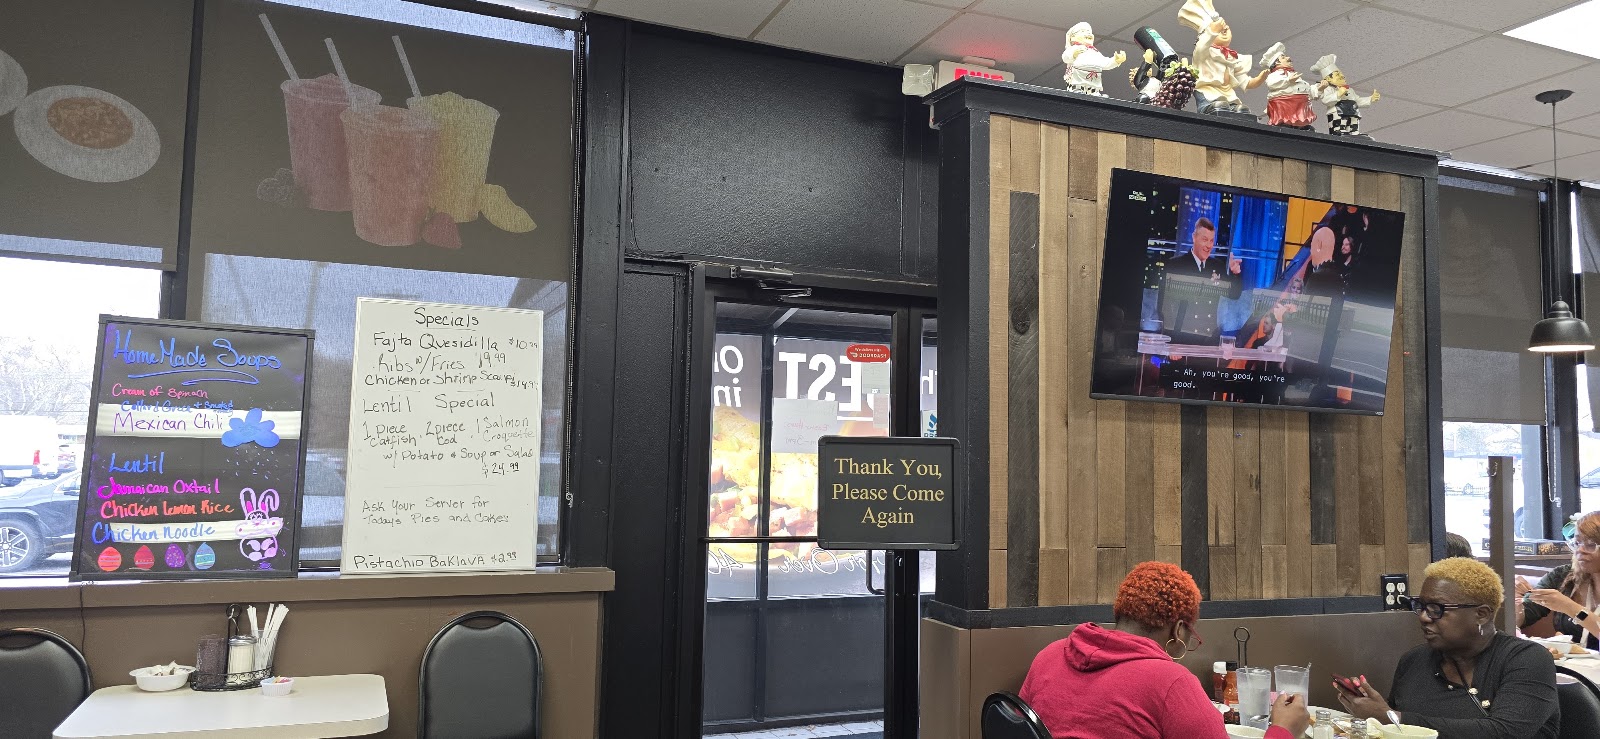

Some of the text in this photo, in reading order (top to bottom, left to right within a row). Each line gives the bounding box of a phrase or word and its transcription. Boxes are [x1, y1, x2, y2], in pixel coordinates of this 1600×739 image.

[414, 306, 479, 328] Specials
[213, 338, 282, 370] Soups
[378, 353, 413, 373] Ribs
[364, 374, 417, 386] Chicken
[419, 377, 431, 385] or
[432, 371, 478, 385] Shrimp
[1173, 380, 1196, 389] good.
[1183, 369, 1197, 377] Ah,
[1202, 370, 1230, 379] you're
[1232, 372, 1254, 382] good,
[1259, 374, 1285, 383] you're
[112, 383, 209, 400] Cream of Spinach
[362, 391, 495, 414] Lentil Special
[113, 412, 223, 434] Mexican Chili
[426, 421, 435, 436] 2
[483, 414, 529, 429] Salmon
[109, 451, 165, 475] Lentil
[401, 449, 444, 461] Potato
[460, 447, 487, 464] Soup
[503, 445, 534, 458] Salad
[833, 457, 942, 480] Thank You,
[97, 476, 220, 499] Jamaican Oxtail
[831, 482, 945, 502] Please Come
[100, 500, 158, 519] Chicken
[200, 499, 234, 514] Rice
[425, 496, 465, 510] Server
[410, 513, 440, 523] Pies
[448, 512, 472, 523] and
[860, 506, 915, 528] Again
[91, 521, 159, 545] Chicken
[353, 554, 424, 569] Pistachio
